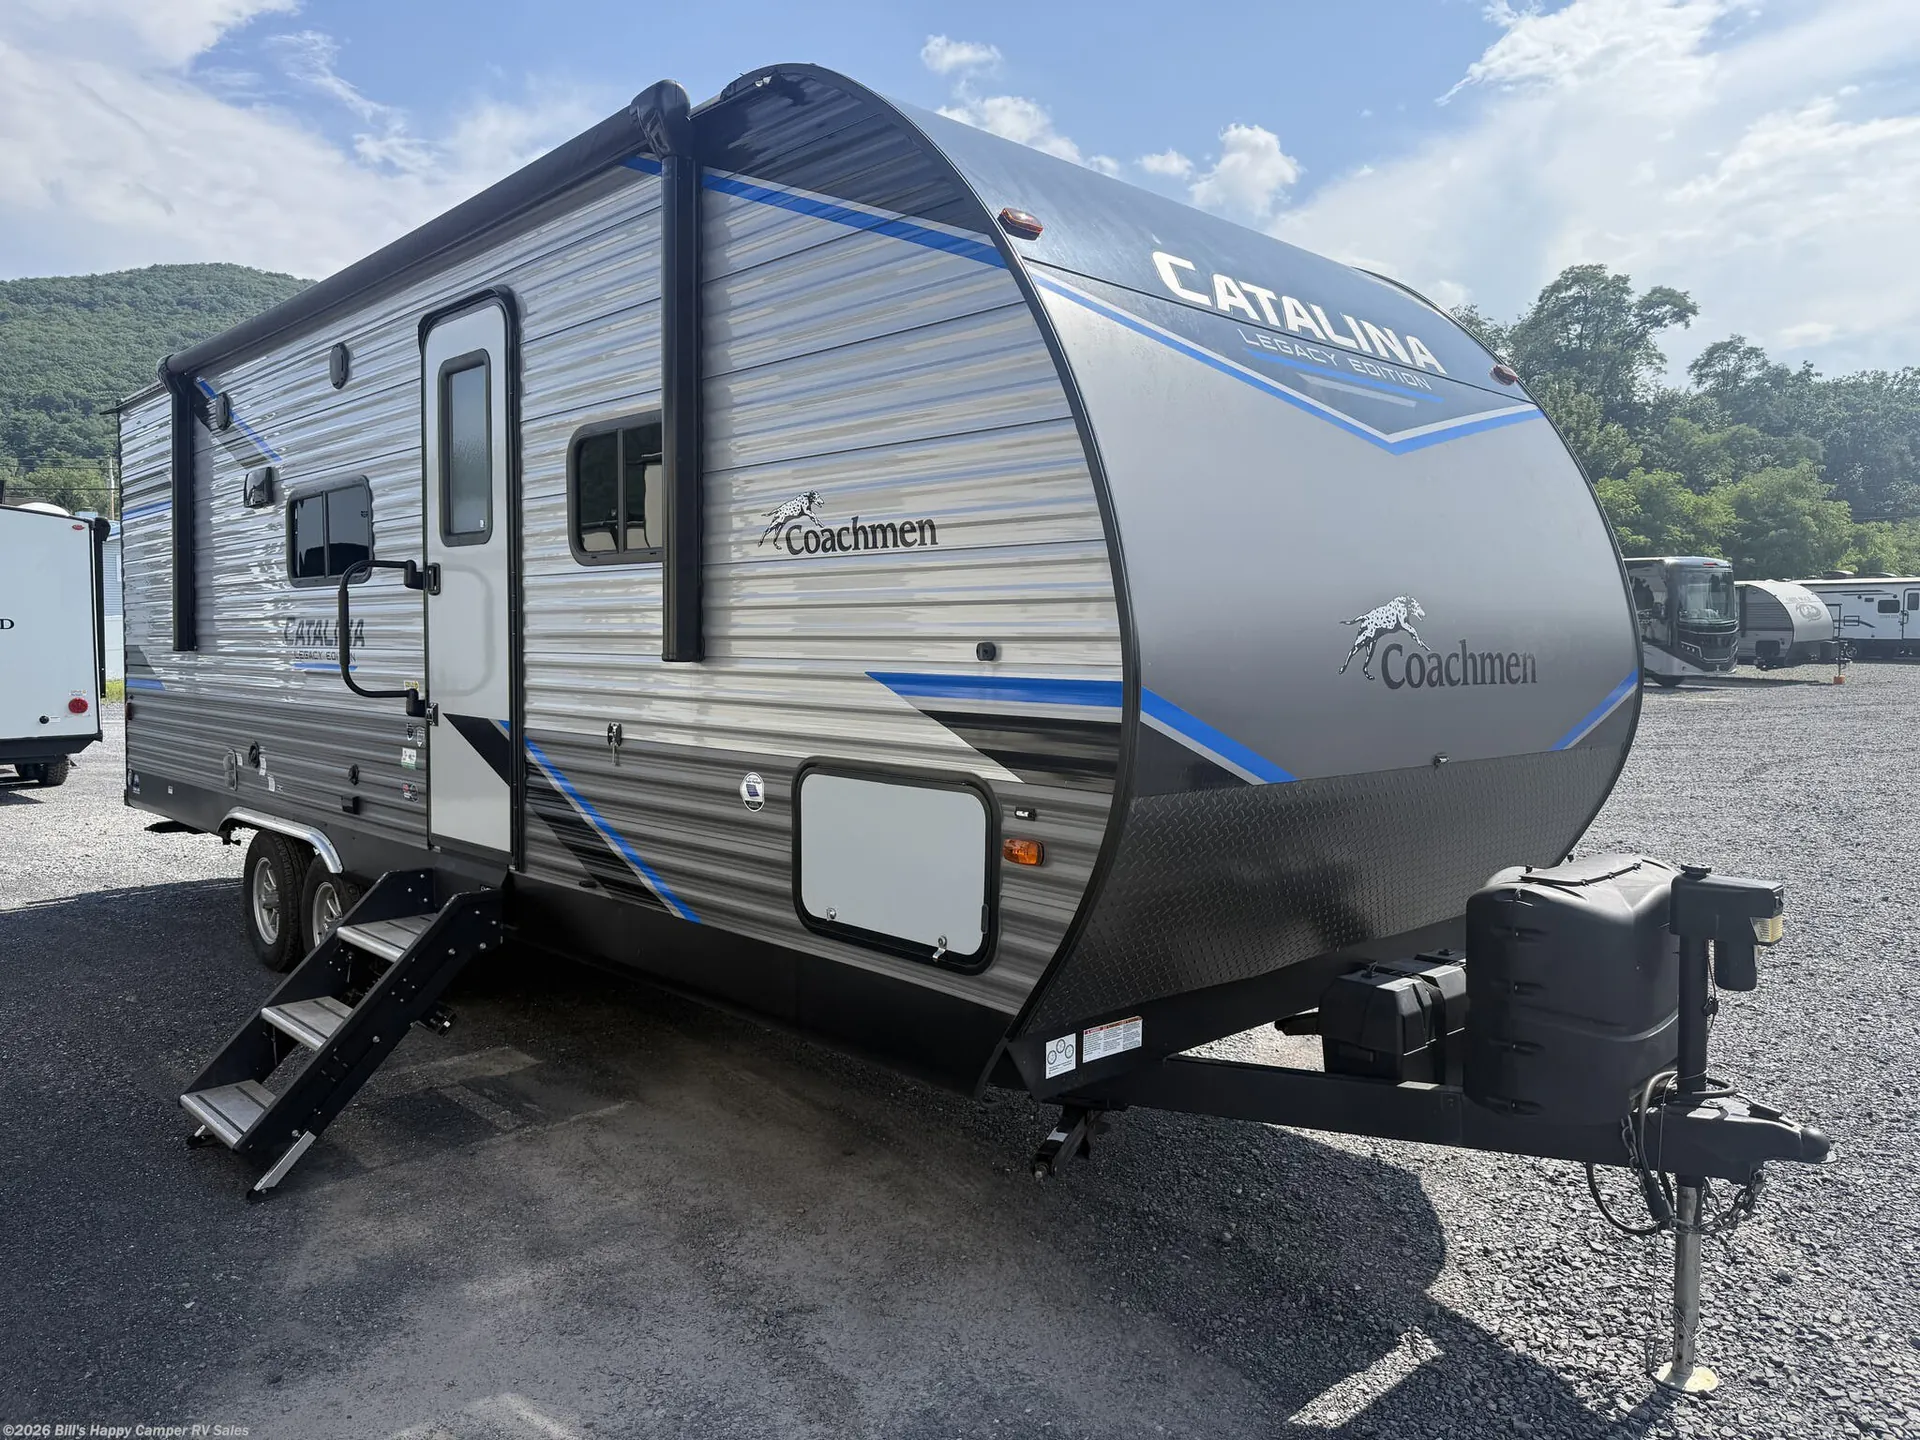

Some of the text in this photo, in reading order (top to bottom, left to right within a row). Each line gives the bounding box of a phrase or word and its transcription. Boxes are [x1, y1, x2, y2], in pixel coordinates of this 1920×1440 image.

[1152, 250, 1447, 375] CATALINA
[1239, 329, 1432, 391] LEGACY EDITION
[786, 516, 938, 555] Coachmen
[1381, 639, 1538, 690] Coachmen
